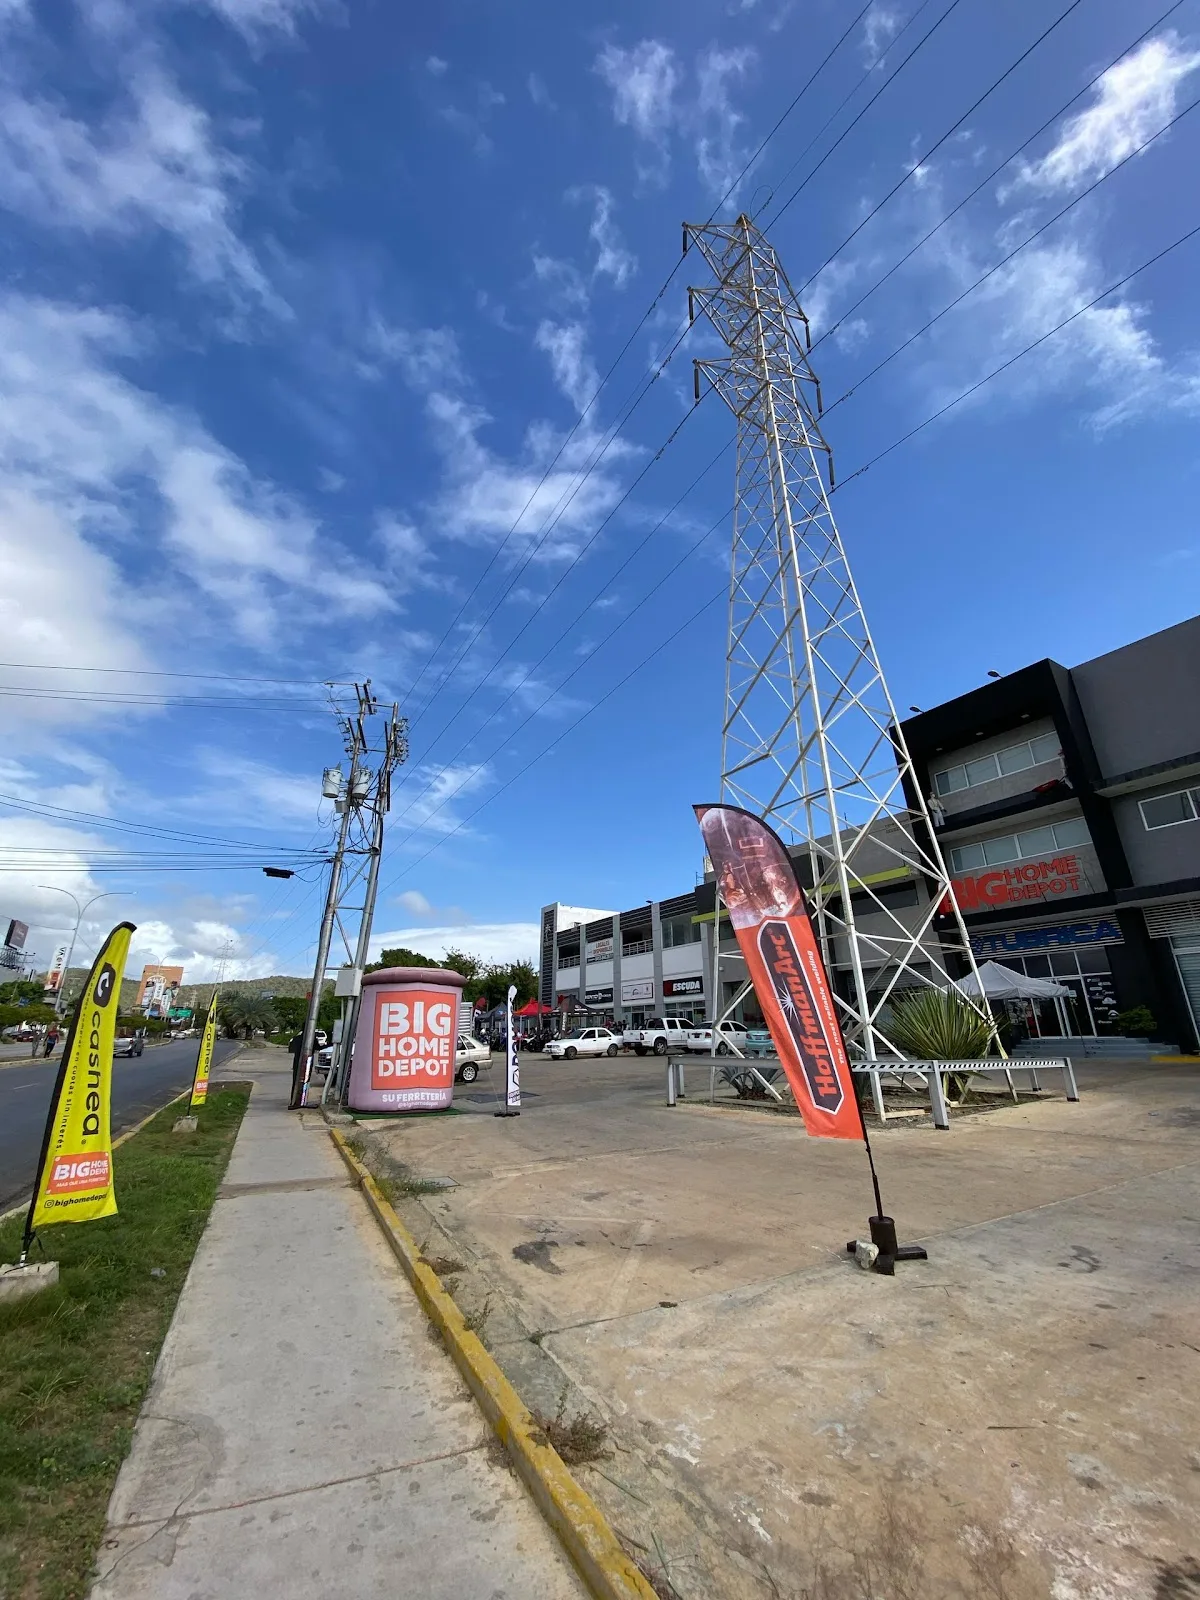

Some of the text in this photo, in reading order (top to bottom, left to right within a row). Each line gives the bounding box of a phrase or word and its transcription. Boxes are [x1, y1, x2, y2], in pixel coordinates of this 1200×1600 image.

[1003, 855, 1079, 885] HOME
[939, 872, 1009, 916] BIG
[1008, 875, 1081, 902] DEPOT
[672, 981, 700, 991] ESCUDA
[380, 1001, 451, 1036] BIG
[807, 950, 845, 1065] The most reliable welding
[379, 1036, 450, 1057] HOME
[68, 1065, 77, 1095] cuotas
[82, 1010, 101, 1136] cashea
[379, 1058, 449, 1077] DEPOT
[382, 1091, 446, 1102] SU FERRETERÍA
[53, 1161, 91, 1181] BIG
